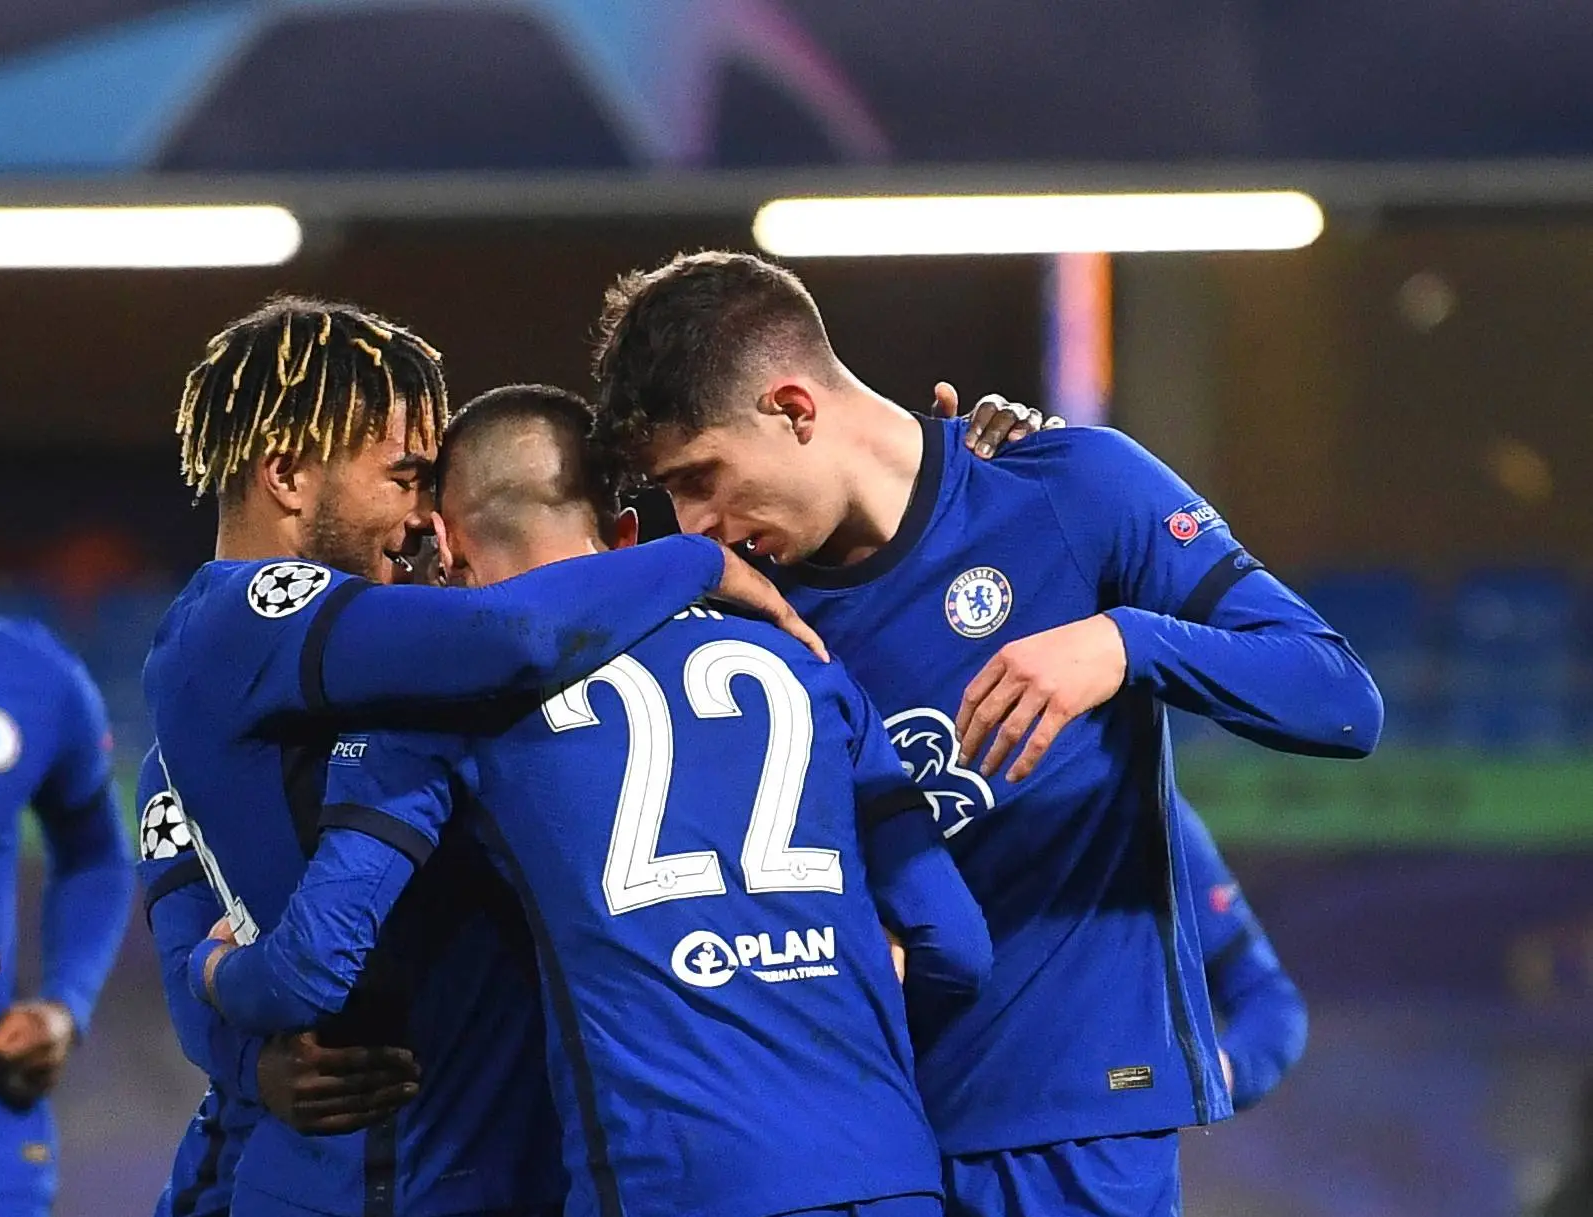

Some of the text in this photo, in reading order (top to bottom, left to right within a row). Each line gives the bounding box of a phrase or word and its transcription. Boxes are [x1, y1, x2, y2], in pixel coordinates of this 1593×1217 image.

[331, 741, 368, 758] PECT
[541, 639, 843, 916] 22
[734, 926, 835, 967] PLAN
